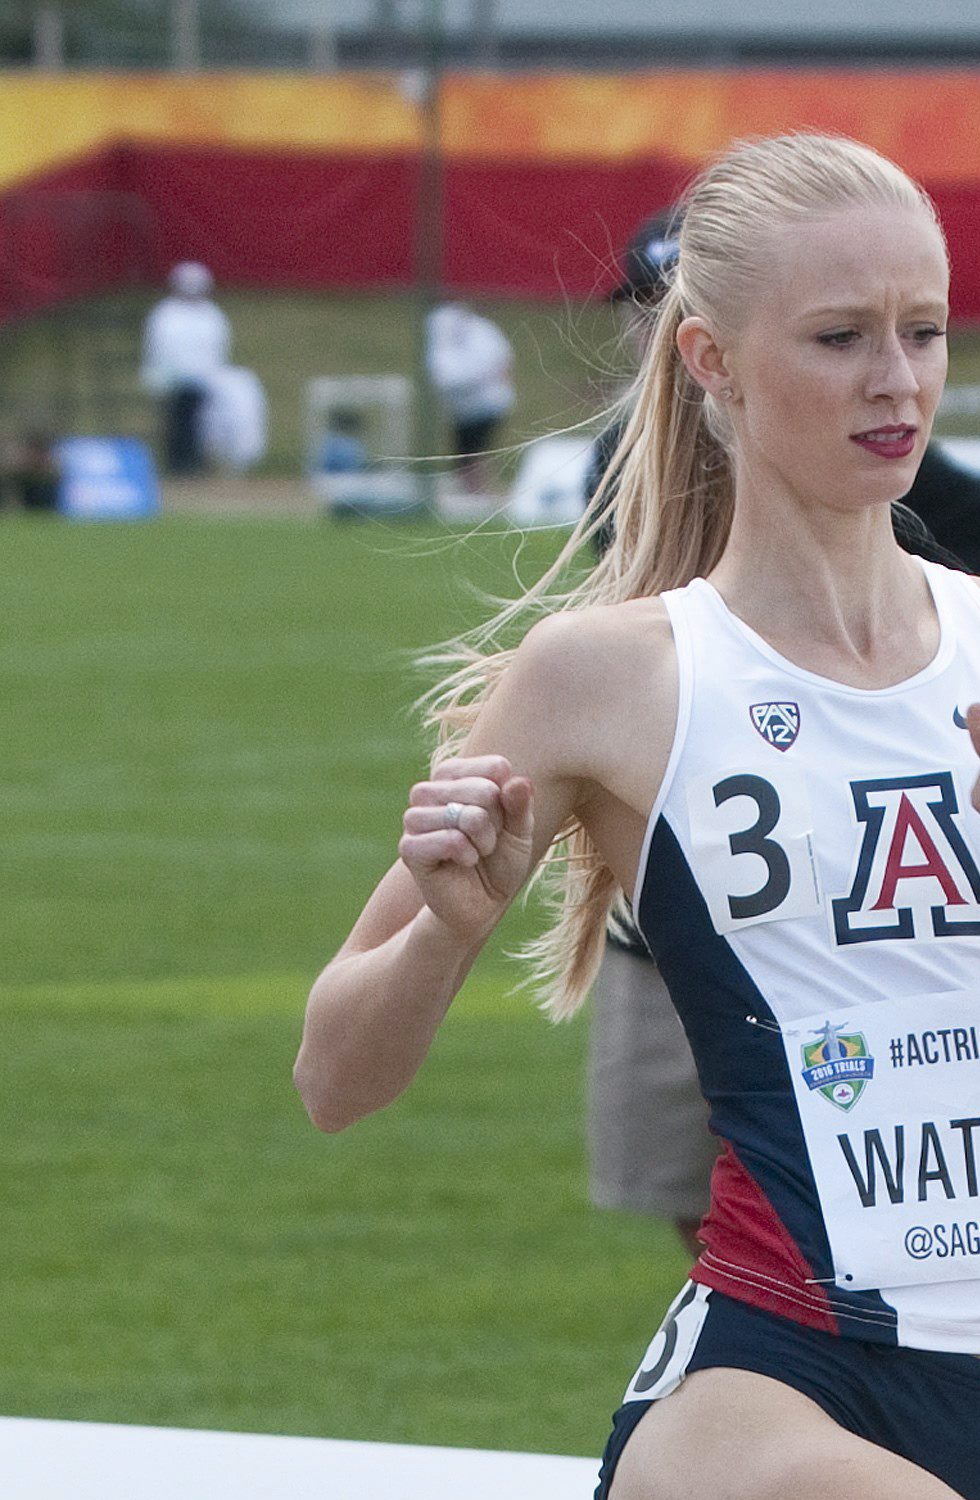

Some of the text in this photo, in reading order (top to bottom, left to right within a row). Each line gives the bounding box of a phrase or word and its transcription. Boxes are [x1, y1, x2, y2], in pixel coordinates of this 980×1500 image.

[752, 704, 798, 734] PAC
[766, 724, 792, 742] 12
[712, 773, 792, 921] 3
[834, 1060, 866, 1074] TRIALS
